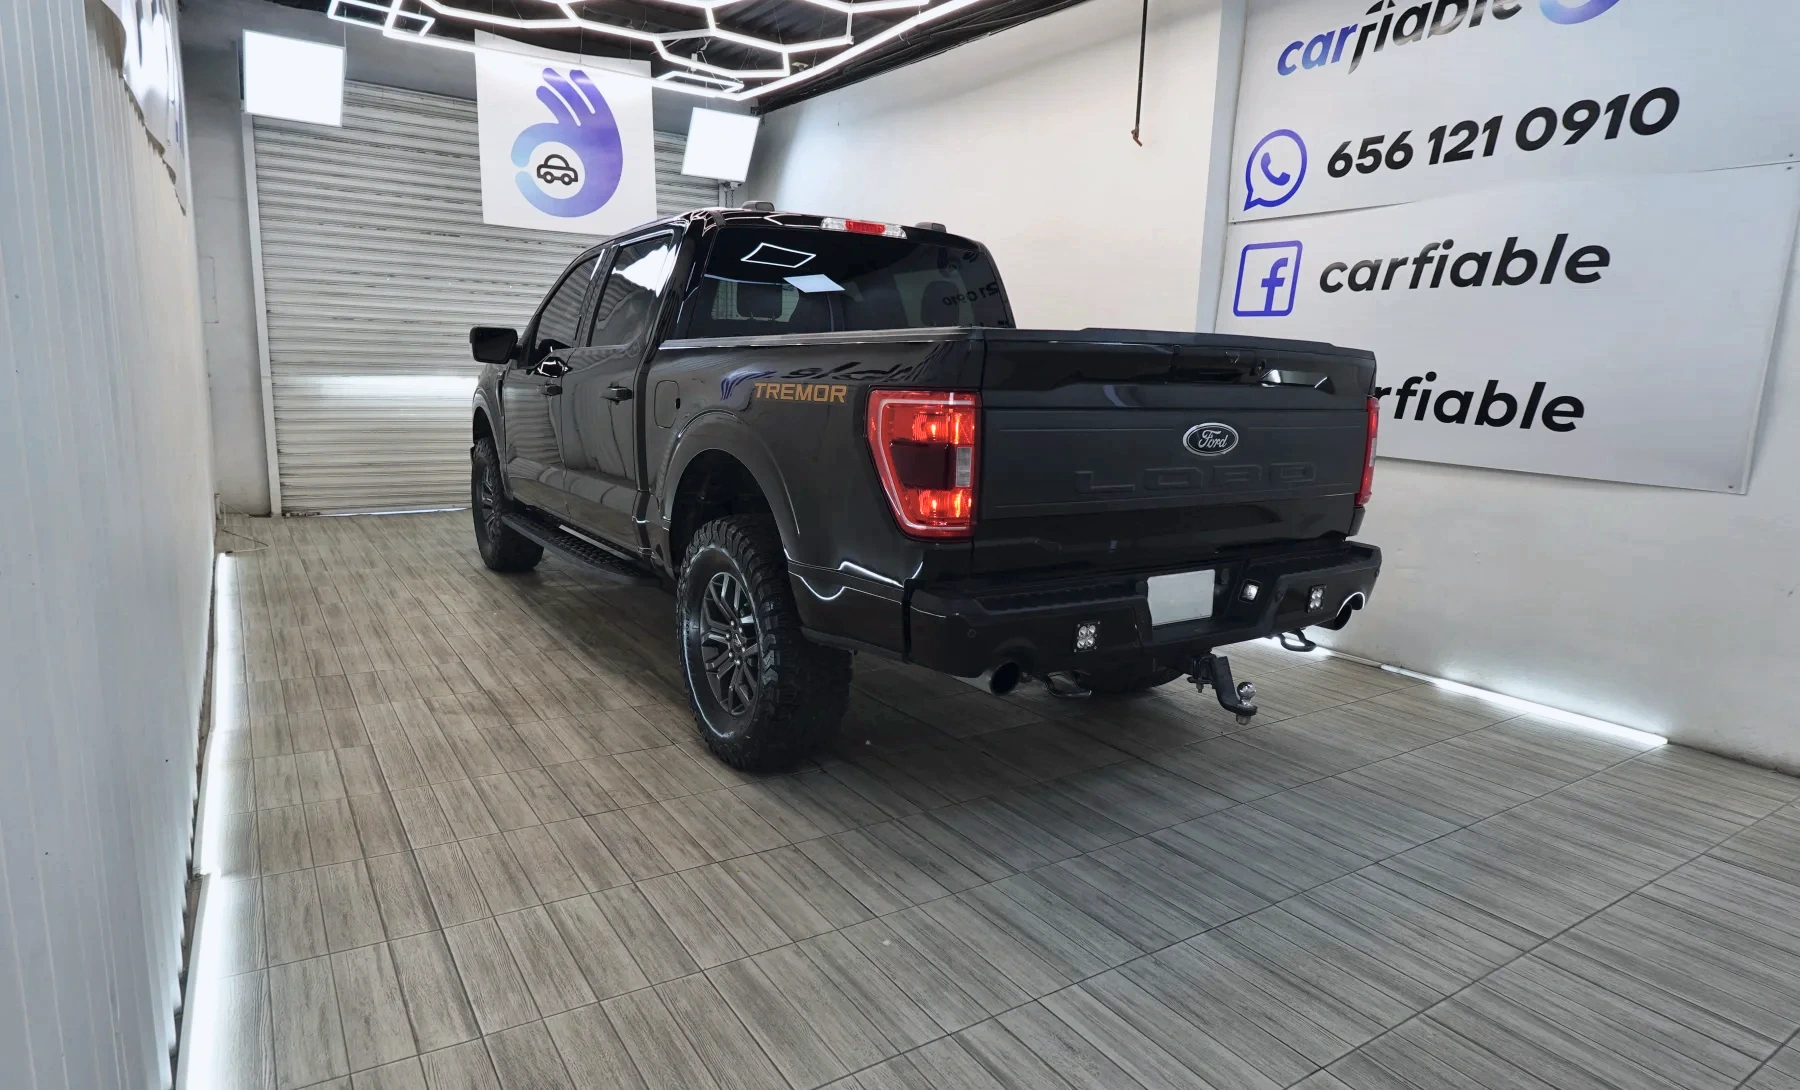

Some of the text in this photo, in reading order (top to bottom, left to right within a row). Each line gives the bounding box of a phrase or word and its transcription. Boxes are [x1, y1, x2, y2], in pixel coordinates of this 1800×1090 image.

[1327, 86, 1681, 179] 656 121 0910
[1319, 233, 1611, 294] carfiable
[754, 382, 847, 403] TREMOR
[1198, 429, 1229, 448] Ford
